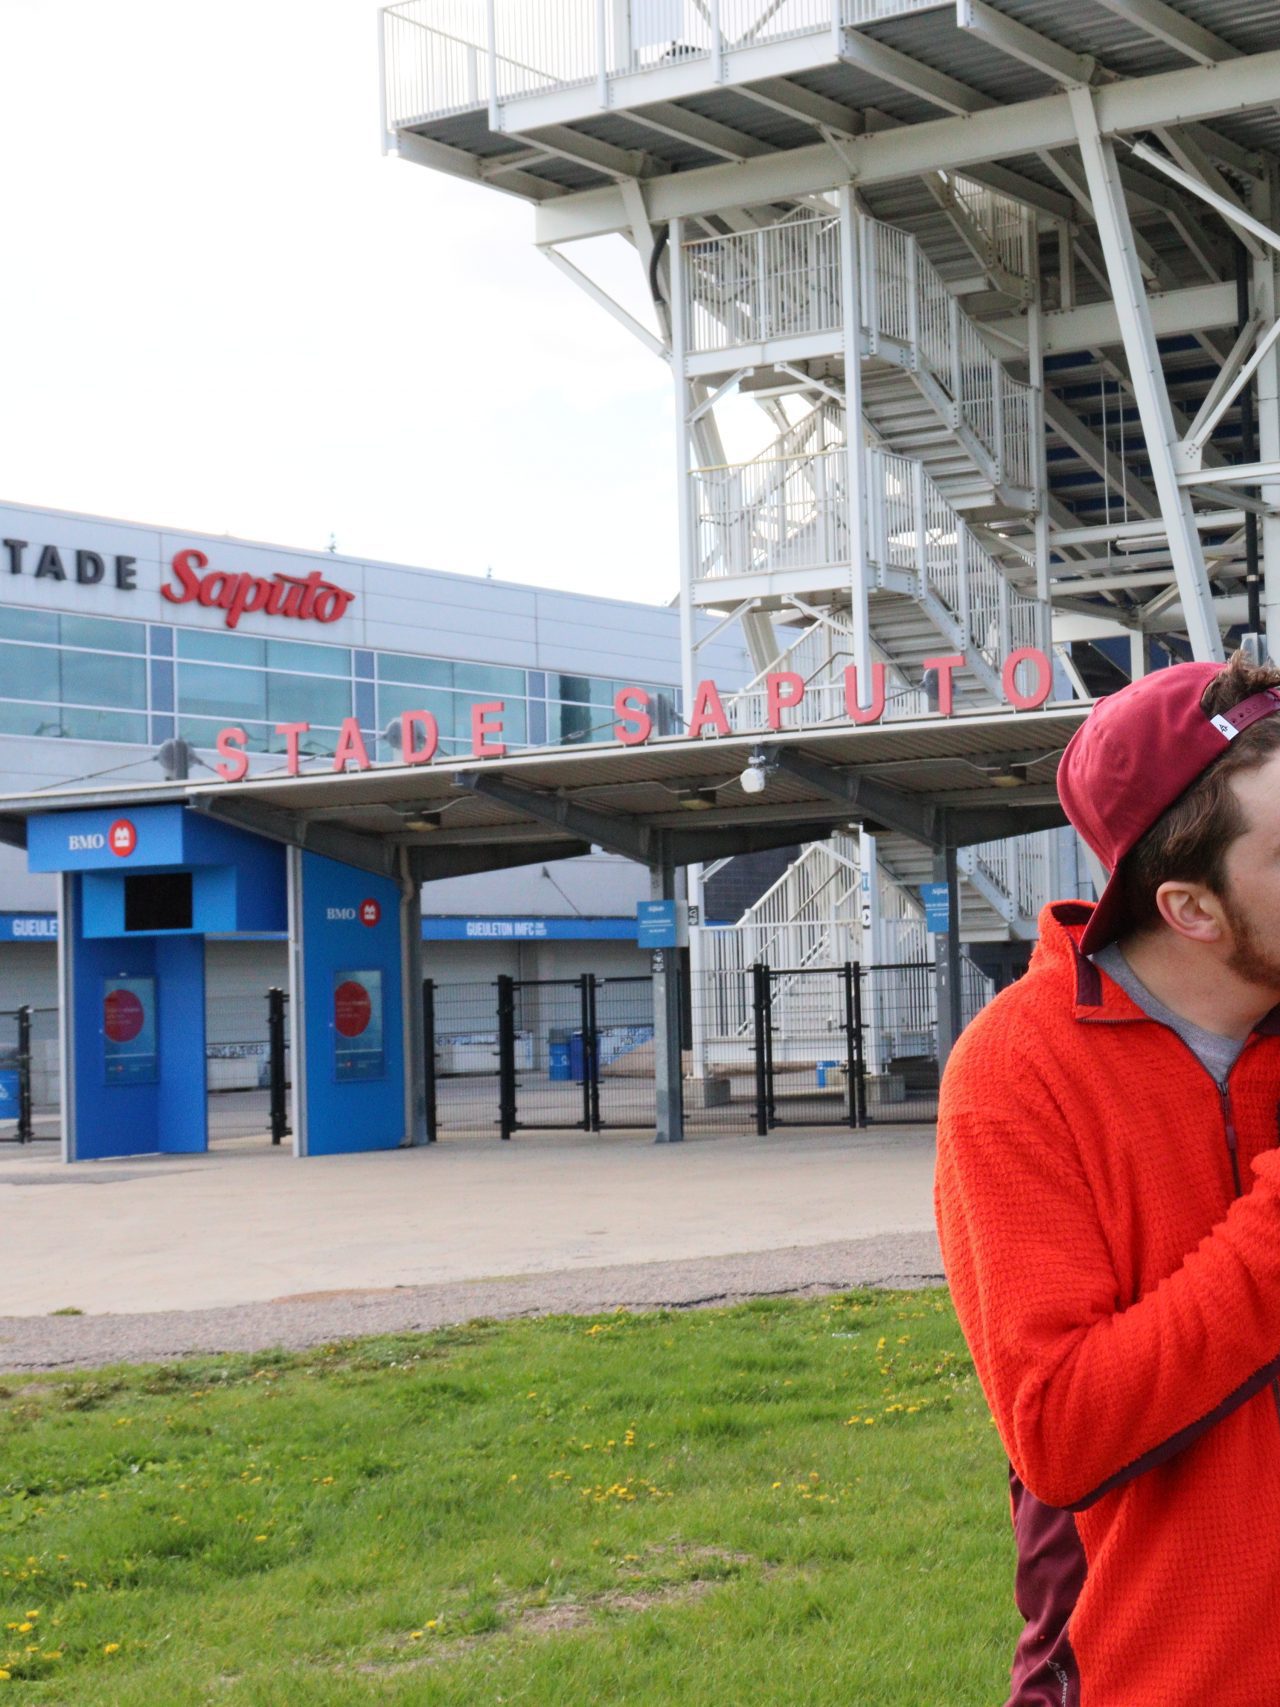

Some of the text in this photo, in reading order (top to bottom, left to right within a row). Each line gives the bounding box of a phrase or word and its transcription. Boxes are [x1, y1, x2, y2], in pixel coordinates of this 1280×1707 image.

[3, 538, 355, 629] TADE Saputo
[216, 646, 1053, 782] STADE SAPUTO
[68, 833, 105, 851] BMO
[326, 907, 356, 920] BMO
